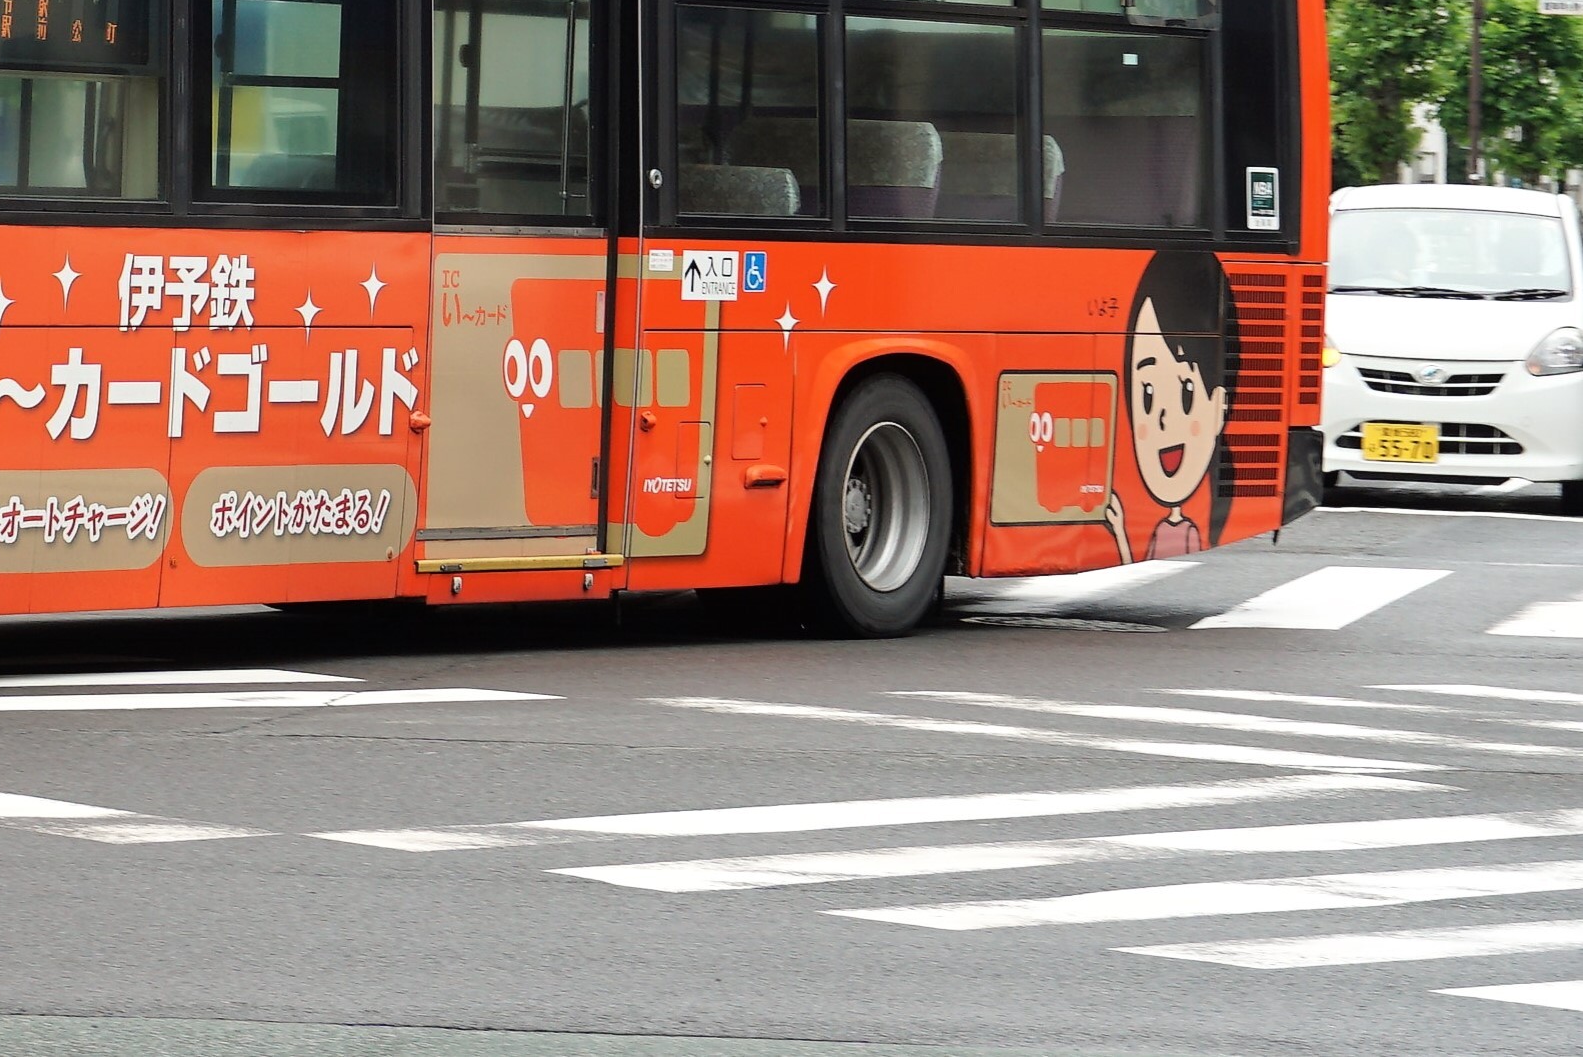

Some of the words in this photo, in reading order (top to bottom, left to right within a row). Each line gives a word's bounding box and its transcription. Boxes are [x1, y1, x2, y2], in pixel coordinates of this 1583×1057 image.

[705, 256, 733, 277] 入口
[442, 270, 460, 288] IC
[701, 281, 736, 295] ENTRANCE
[118, 253, 255, 332] 伊予鉄
[643, 477, 691, 494] IYOTETSU
